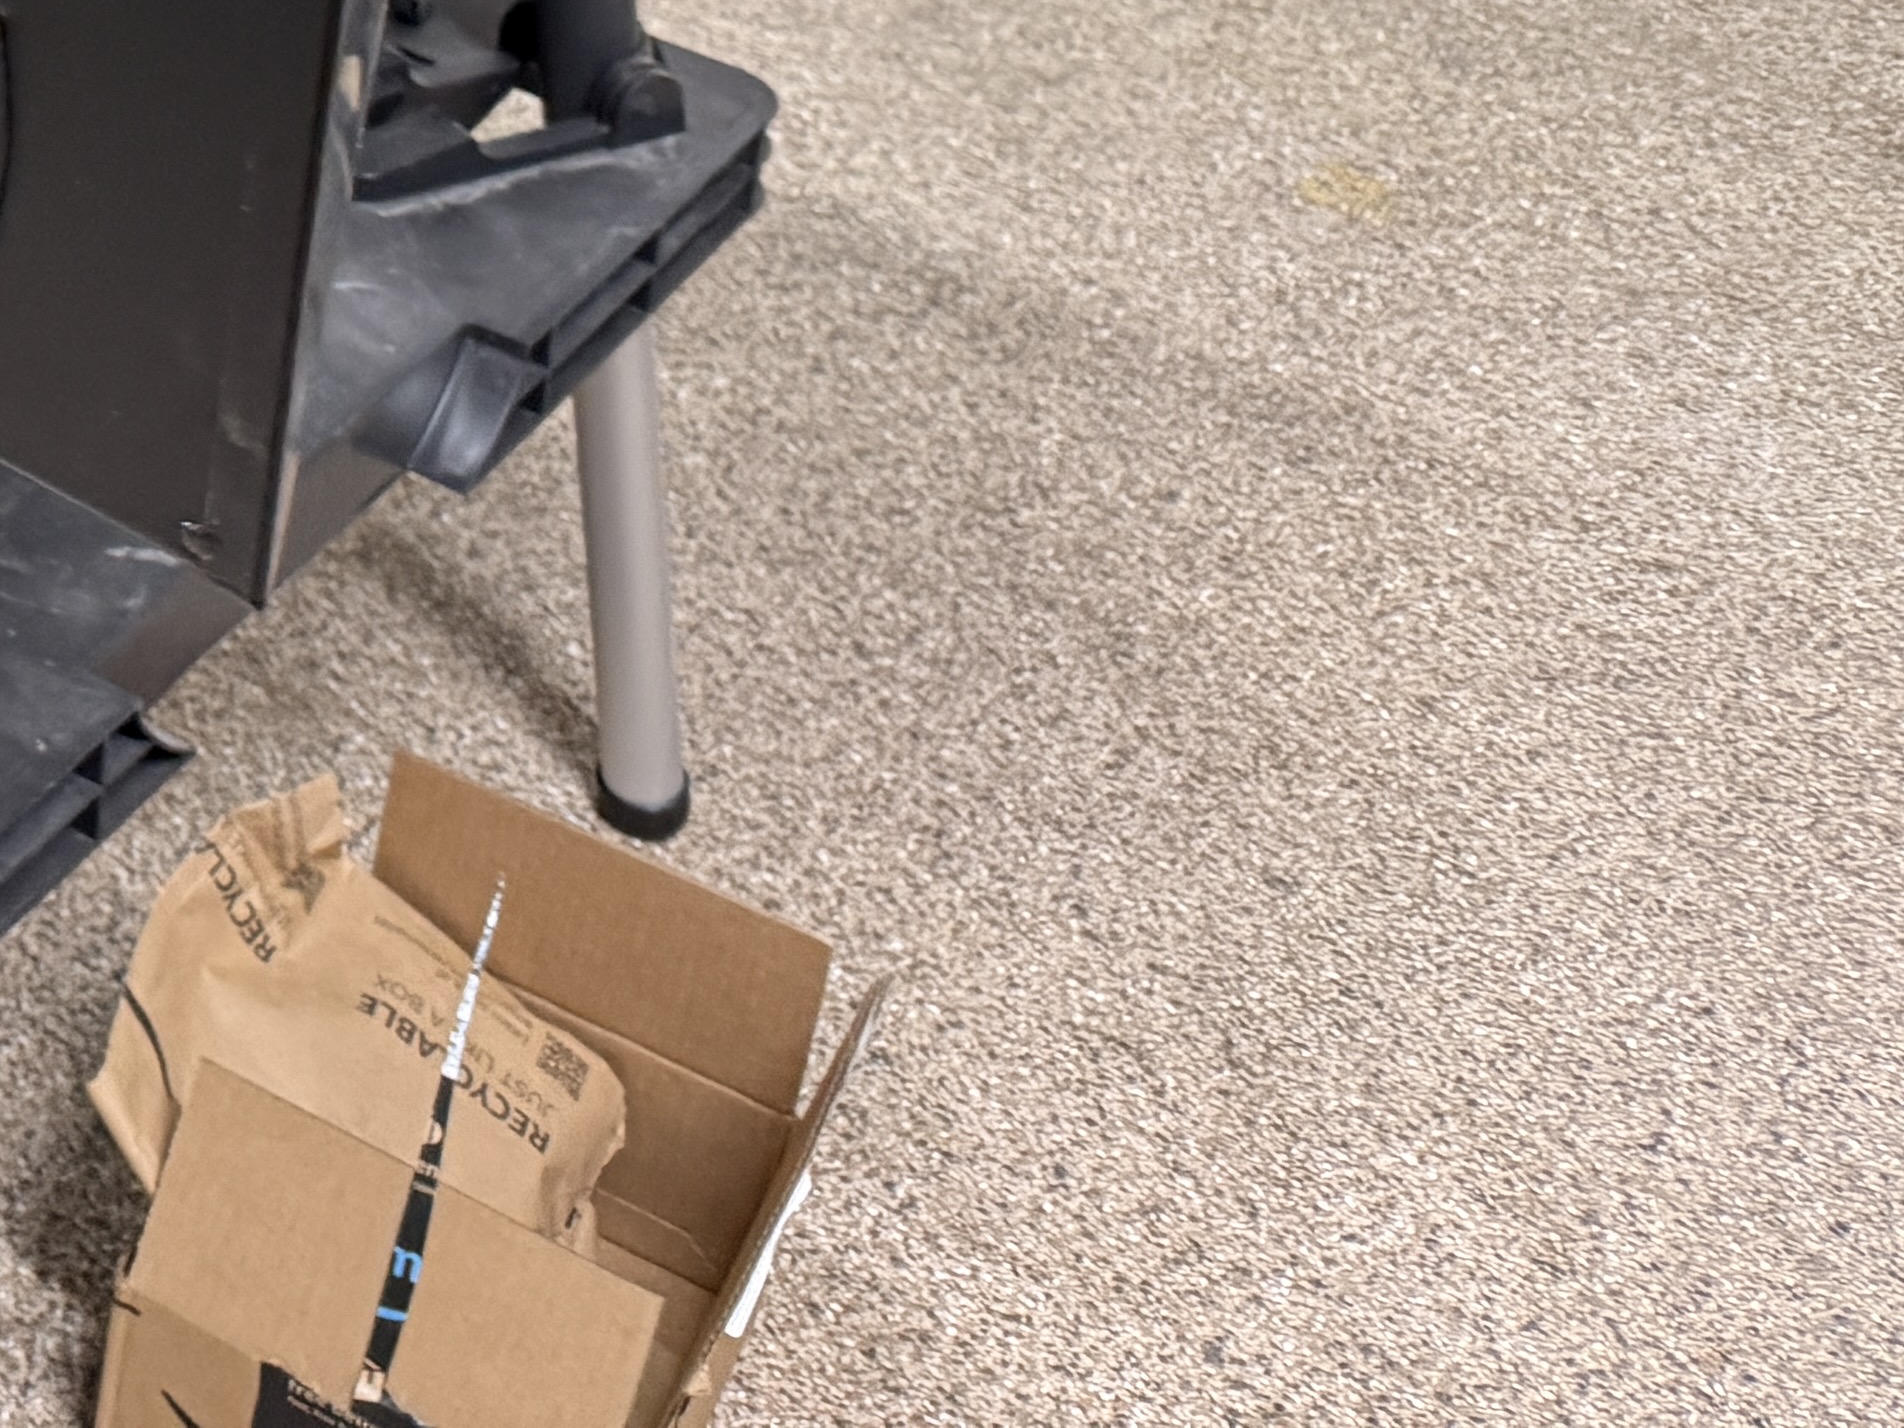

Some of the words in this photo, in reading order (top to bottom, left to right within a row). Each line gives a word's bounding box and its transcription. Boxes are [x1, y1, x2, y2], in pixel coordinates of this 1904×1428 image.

[374, 973, 424, 1015] BOX
[356, 993, 550, 1154] RECYCABLE
[502, 1072, 554, 1118] JUST
